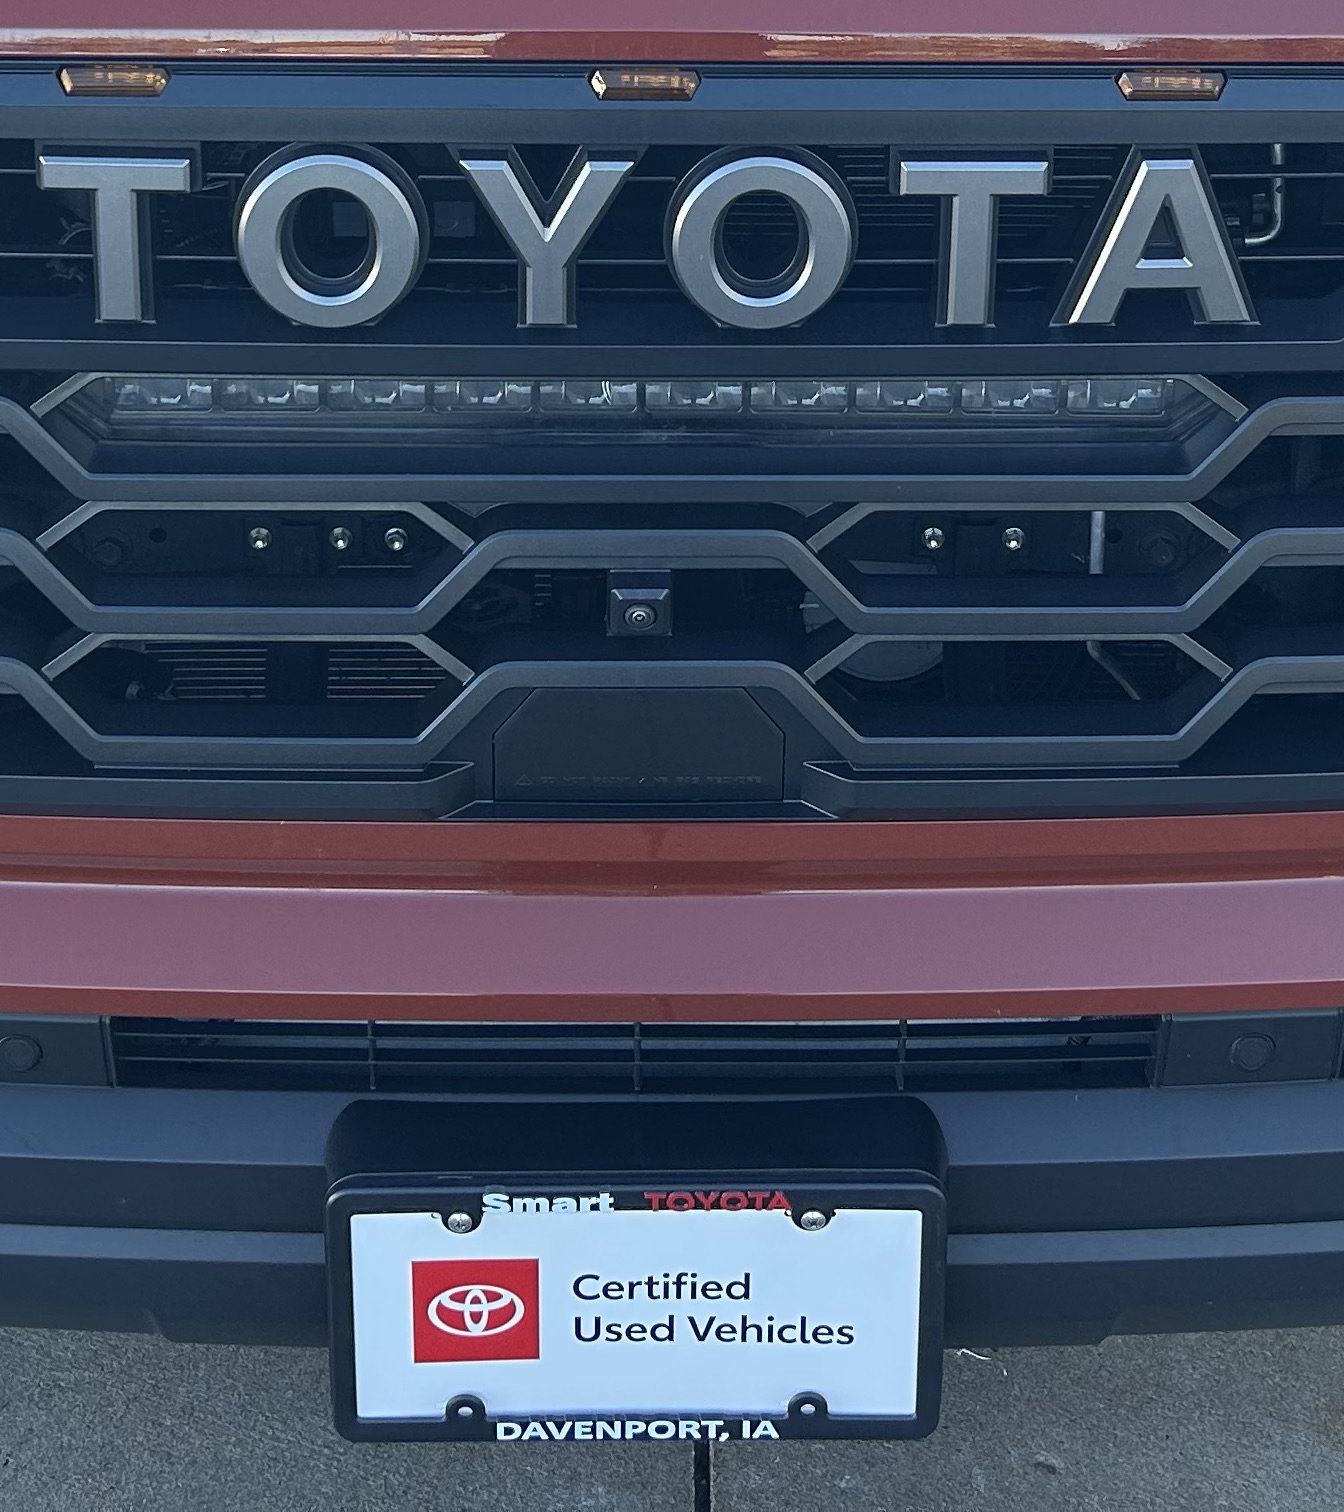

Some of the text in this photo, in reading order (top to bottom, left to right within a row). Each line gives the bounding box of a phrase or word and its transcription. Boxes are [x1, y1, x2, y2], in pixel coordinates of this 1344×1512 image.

[36, 154, 1256, 329] TOYOTA
[481, 1191, 793, 1214] Smart TOYOTA
[573, 1272, 751, 1301] Certified
[574, 1313, 856, 1346] Used Vehicles
[496, 1419, 780, 1441] DAVENPORT, IA
